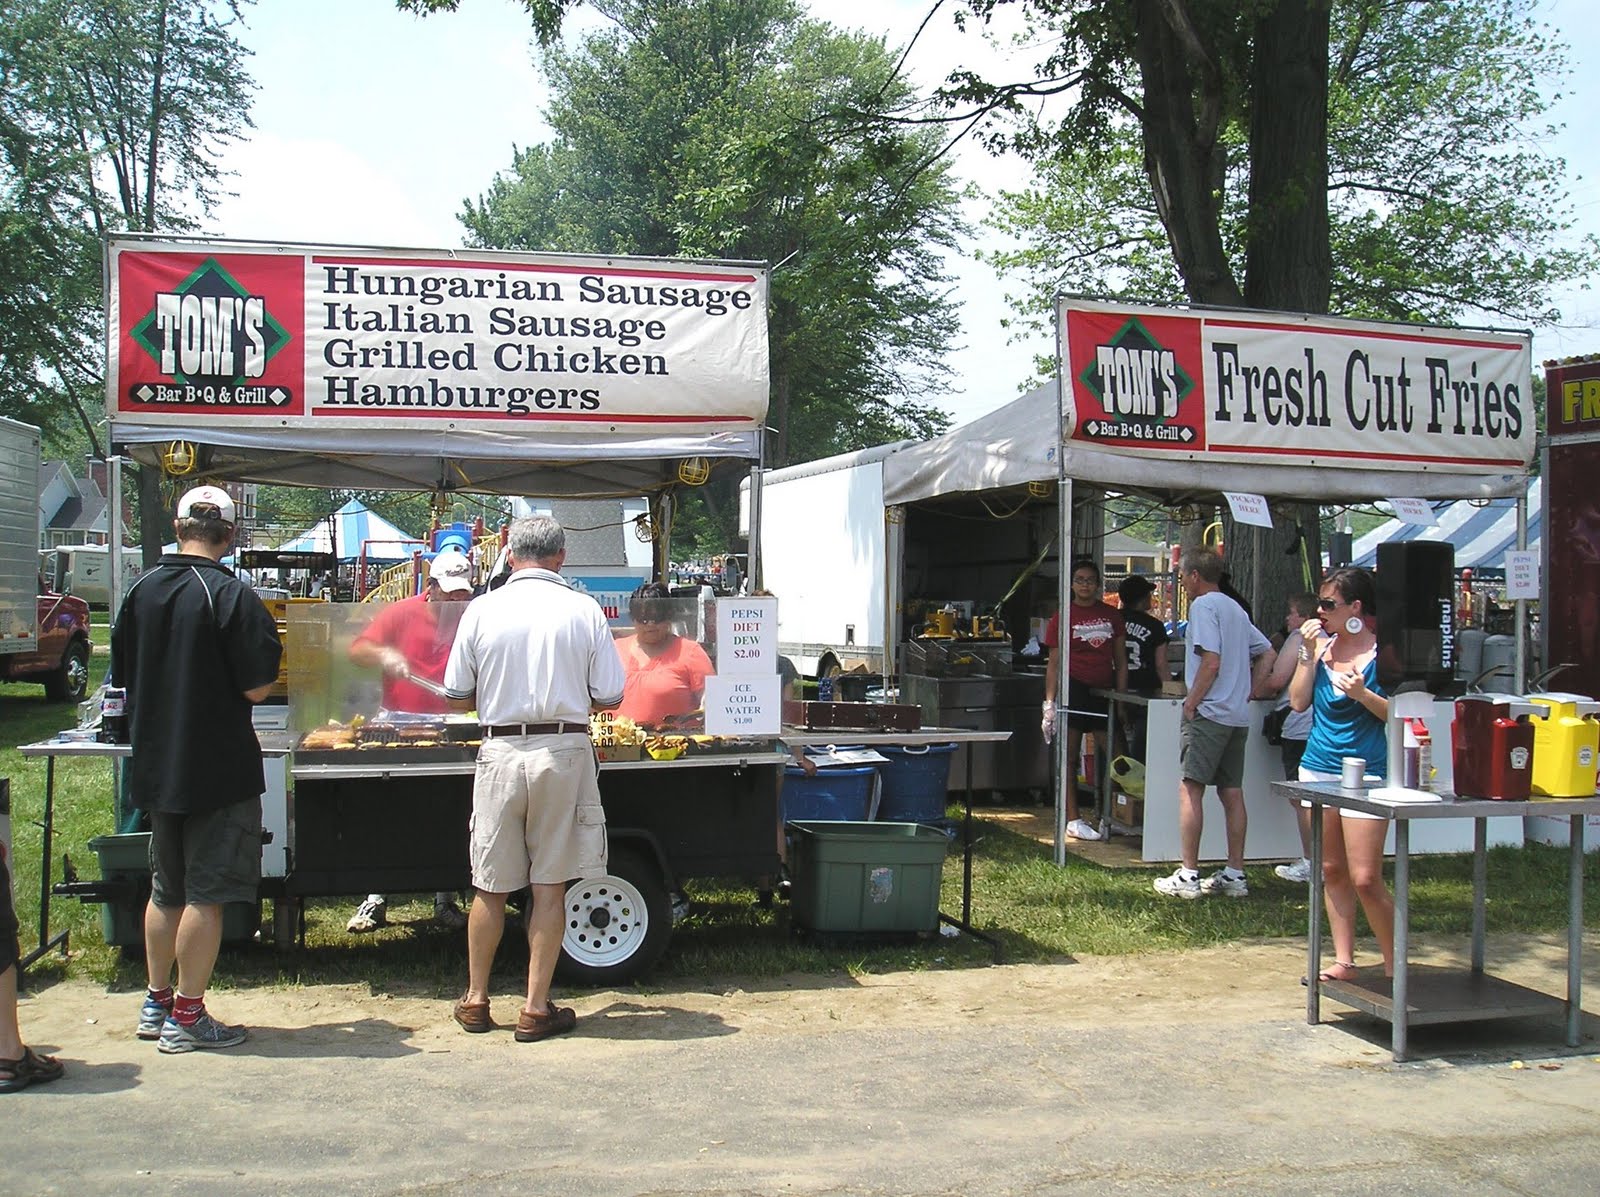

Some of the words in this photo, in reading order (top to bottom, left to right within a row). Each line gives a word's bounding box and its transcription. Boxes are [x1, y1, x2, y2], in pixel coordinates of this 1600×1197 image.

[323, 266, 564, 305] Hungarian
[579, 276, 751, 316] Sausage
[323, 302, 474, 334] Italian
[489, 307, 666, 347] Sausage
[157, 294, 265, 378] TOM'S
[323, 338, 478, 371] Grilled
[493, 342, 669, 375] Chicken
[1097, 346, 1178, 418] TOM'S
[156, 385, 182, 402] Bar
[218, 386, 231, 404] &
[235, 386, 267, 404] Grill
[323, 376, 600, 417] Hamburgers
[1212, 342, 1331, 427] Fresh
[1345, 349, 1413, 434] Cut
[1425, 357, 1523, 440] Fries
[1100, 422, 1118, 436] Bar
[1145, 424, 1154, 439] &
[1156, 425, 1179, 440] Grill
[1230, 495, 1263, 504] PICK-UP
[1238, 505, 1259, 513] HERE
[601, 606, 619, 618] ILL
[731, 609, 763, 618] PEPSI
[733, 623, 761, 632] DIET
[733, 636, 761, 645] DEW
[1440, 604, 1454, 668] napkins
[734, 649, 760, 659] $2.00
[734, 684, 752, 692] ICE
[729, 695, 757, 703] COLD
[589, 712, 613, 722] 2.00
